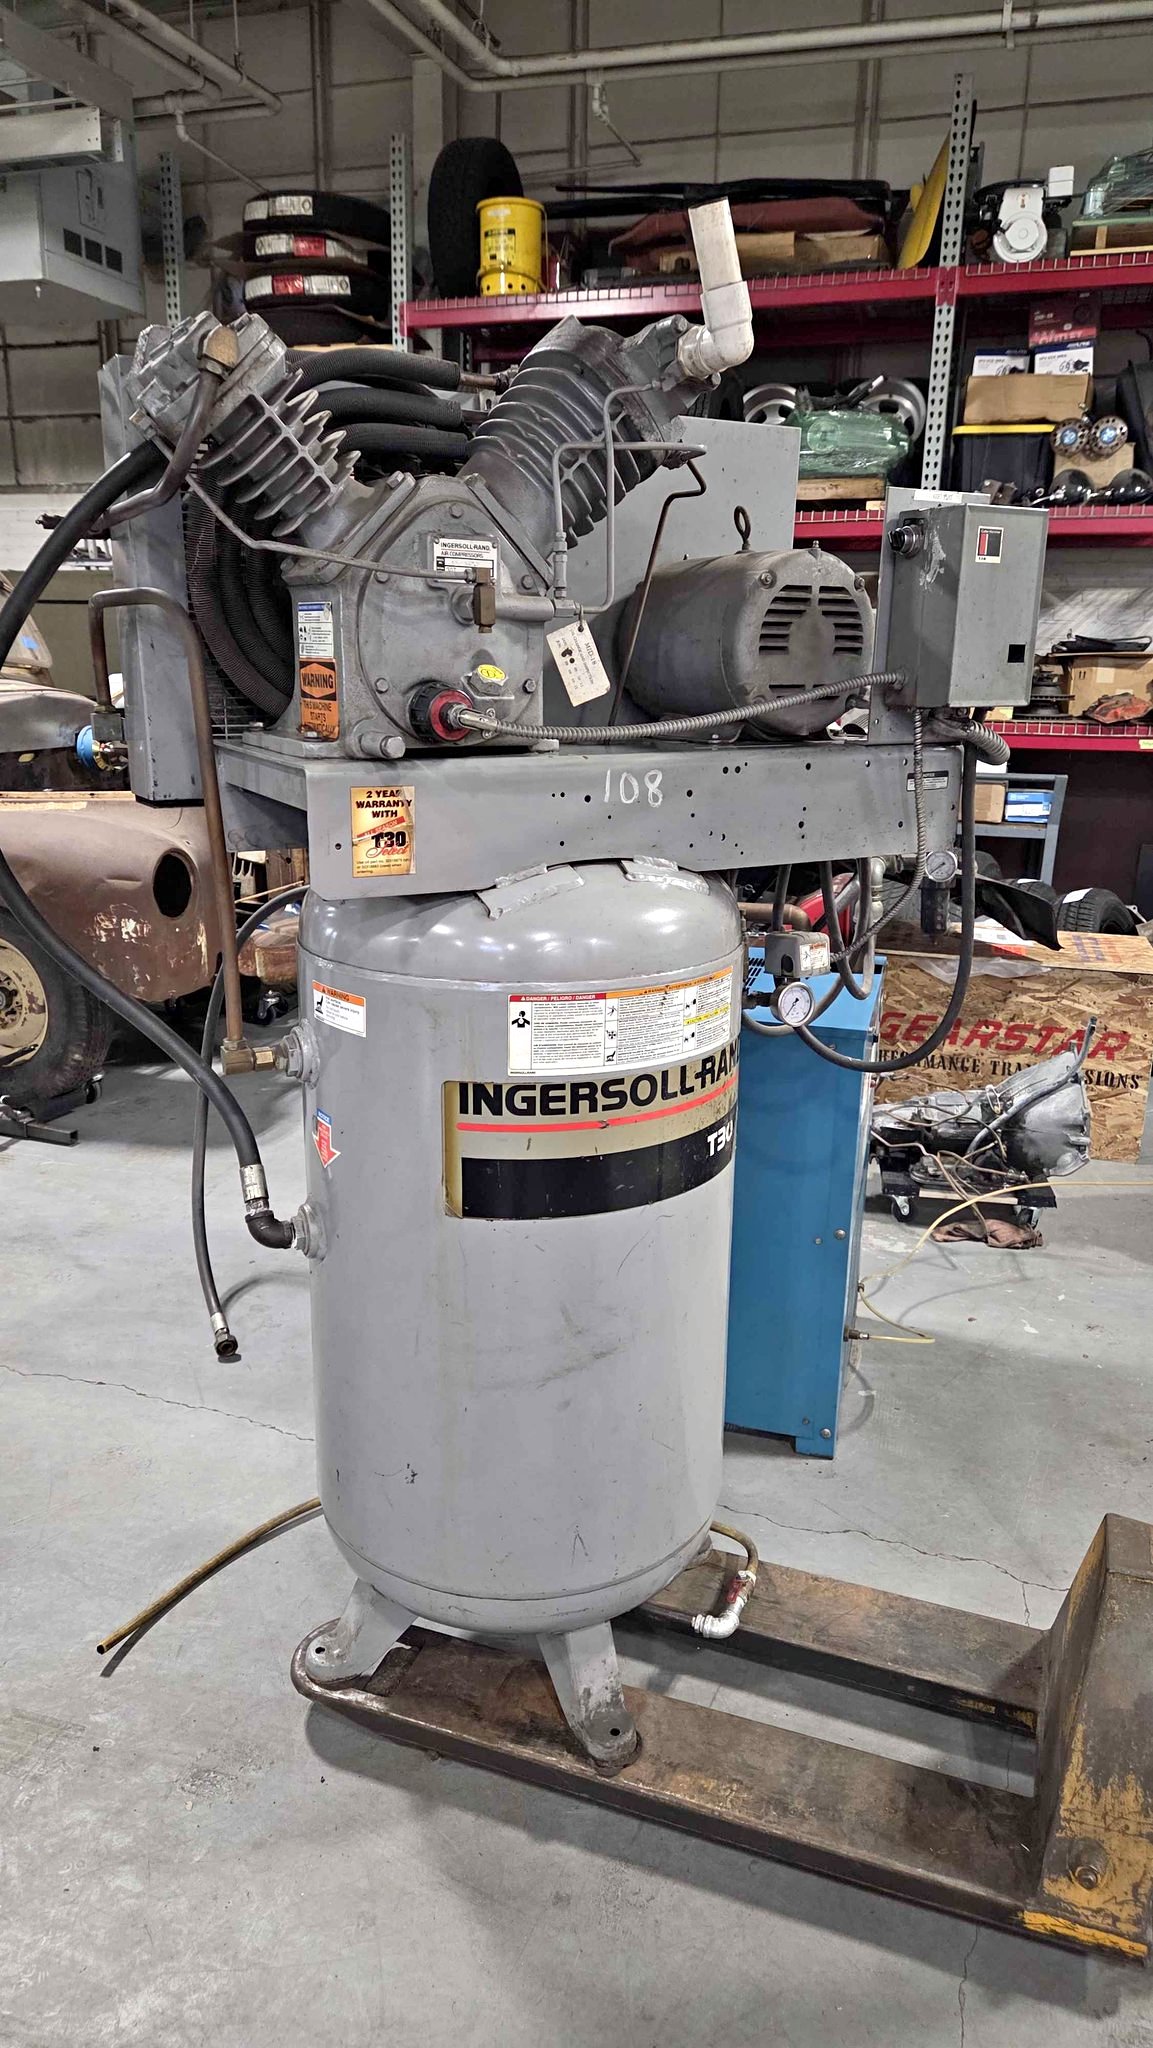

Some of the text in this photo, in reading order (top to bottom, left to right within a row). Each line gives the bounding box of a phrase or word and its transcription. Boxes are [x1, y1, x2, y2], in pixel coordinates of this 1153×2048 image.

[301, 672, 334, 689] WARNING
[366, 790, 373, 798] 2
[603, 768, 663, 808] 108
[356, 799, 412, 809] WARRANTY
[371, 810, 398, 818] WITH
[371, 830, 407, 849] T30
[327, 989, 350, 1002] WARNING
[879, 1011, 1132, 1061] GEARSTAR
[459, 1036, 739, 1117] INGERSOLL-RAN
